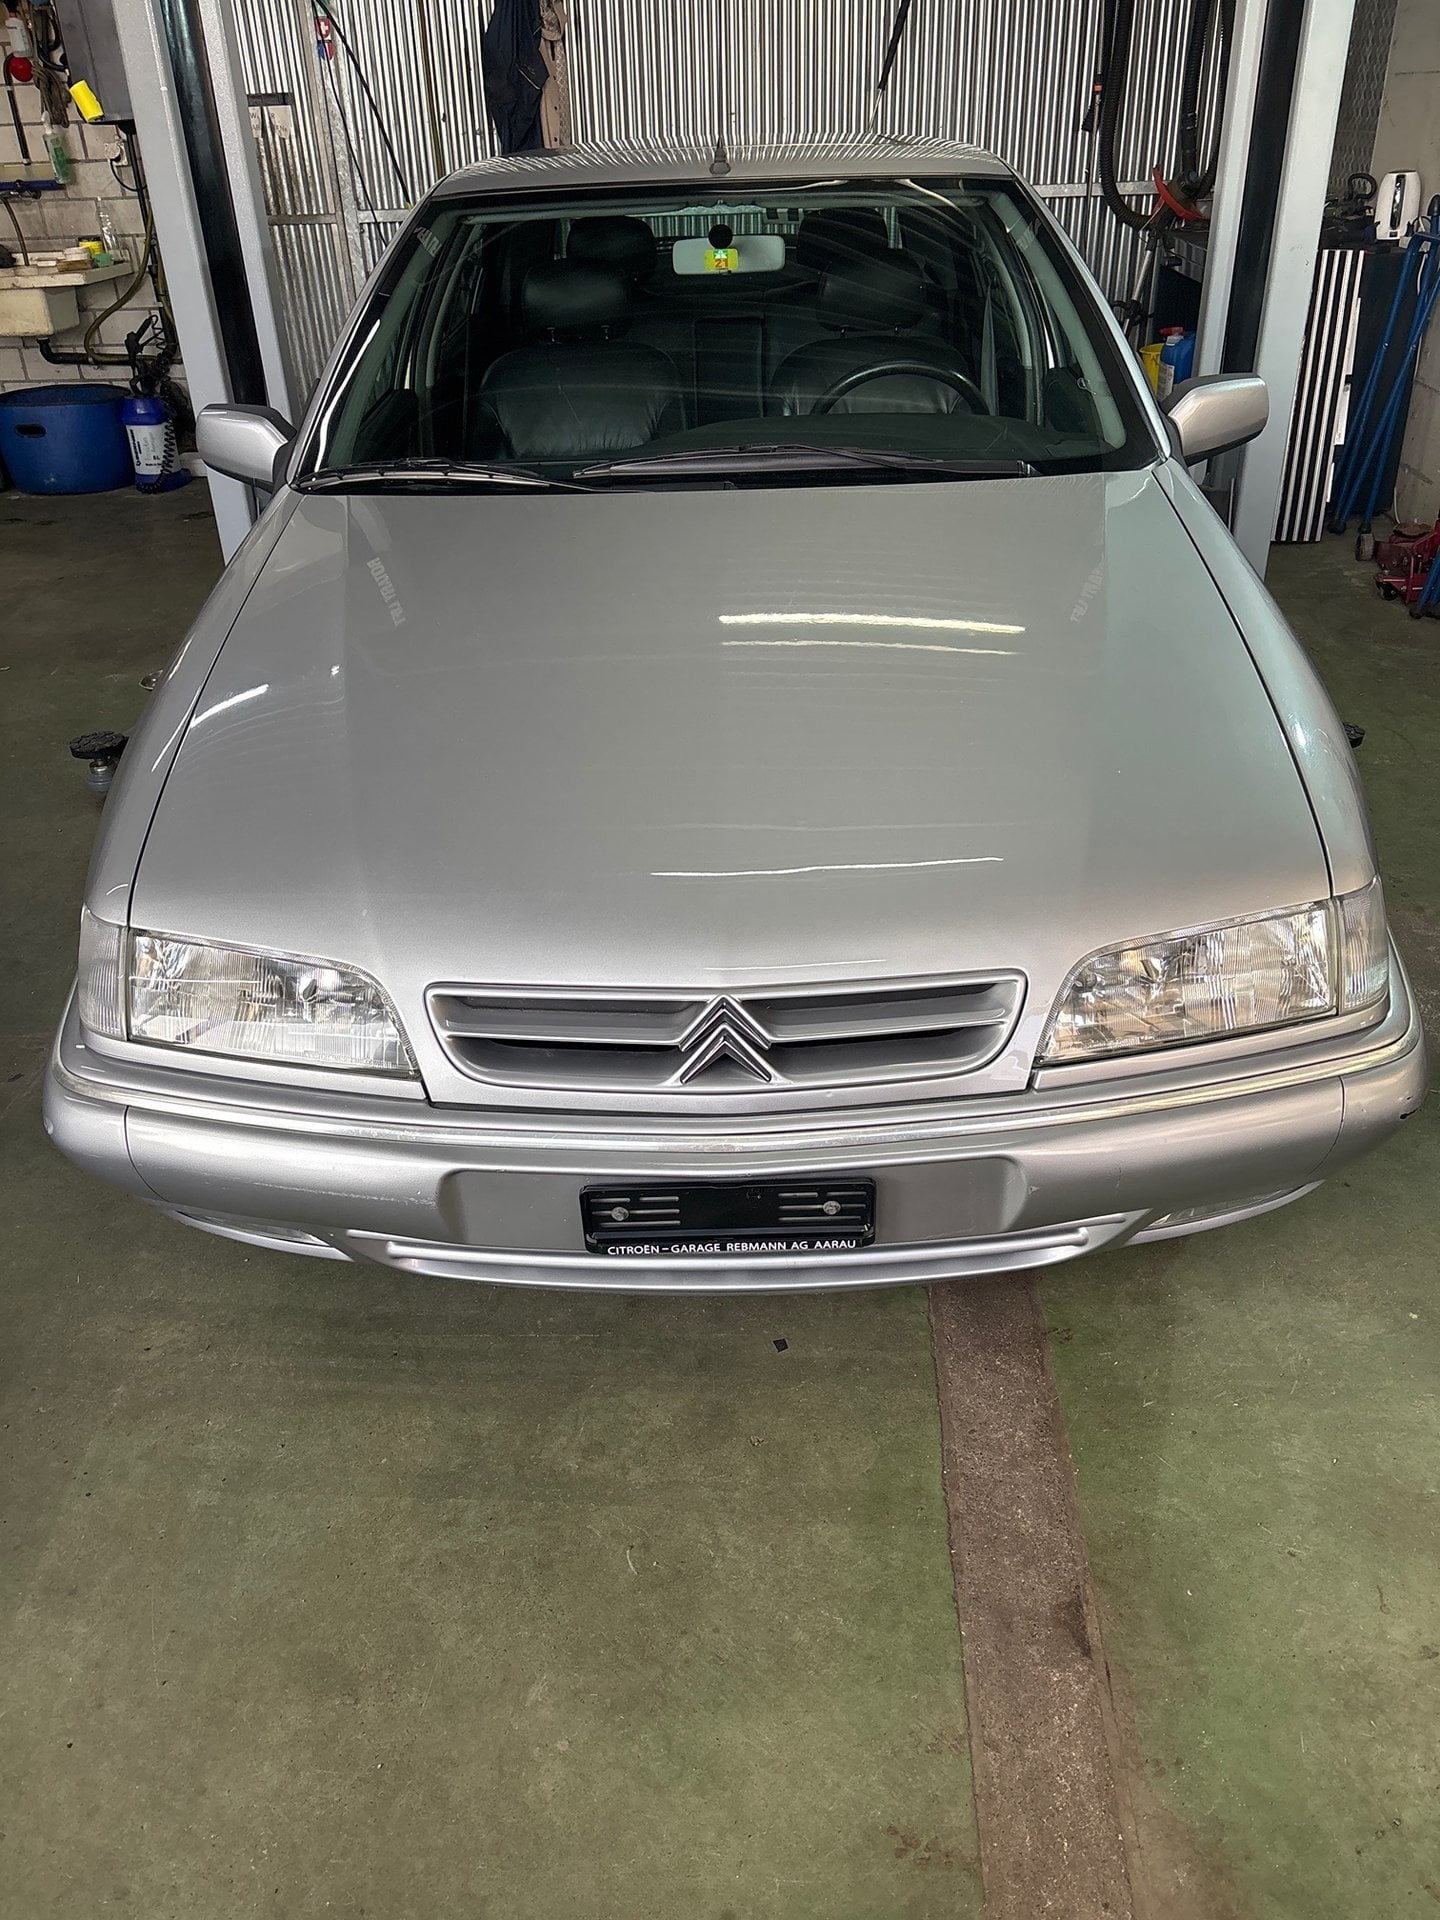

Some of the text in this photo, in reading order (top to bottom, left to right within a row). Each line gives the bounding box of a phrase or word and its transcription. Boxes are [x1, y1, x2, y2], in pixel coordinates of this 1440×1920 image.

[715, 259, 729, 267] 21
[726, 1241, 787, 1252] REBMANN
[790, 1240, 809, 1250] AG
[814, 1239, 856, 1249] AARAU
